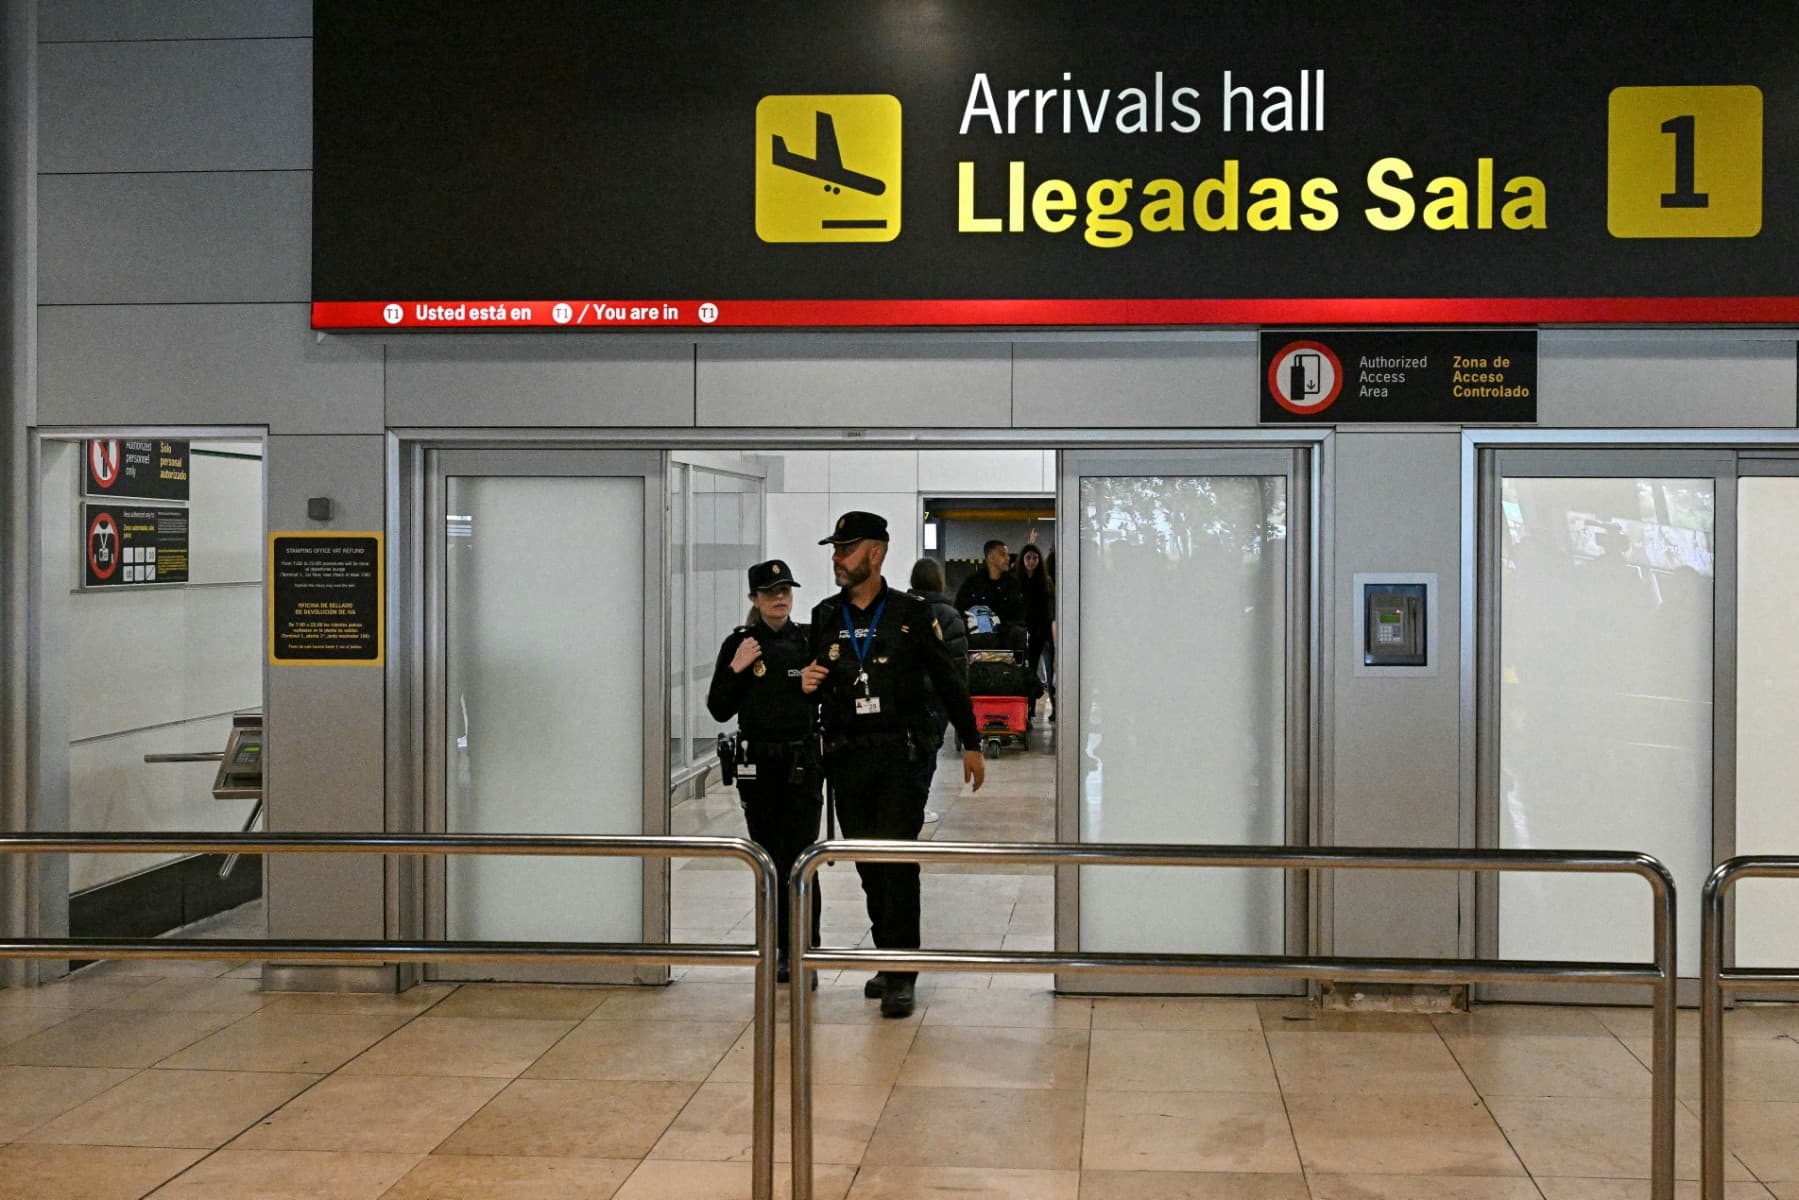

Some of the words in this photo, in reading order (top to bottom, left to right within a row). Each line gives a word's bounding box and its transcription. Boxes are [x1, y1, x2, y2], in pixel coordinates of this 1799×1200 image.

[959, 71, 1201, 134] Arrivals
[1223, 69, 1325, 132] hall
[1660, 115, 1709, 209] 1
[958, 159, 1340, 249] Llegadas
[1364, 156, 1548, 232] Sala
[416, 304, 466, 320] Usted
[469, 304, 507, 320] está
[510, 308, 531, 320] en
[593, 303, 626, 320] You
[630, 307, 659, 320] are
[663, 303, 678, 320] in
[1359, 356, 1427, 369] Authorized
[1453, 356, 1487, 368] Zona
[1493, 356, 1510, 368] de
[1359, 371, 1406, 383] Access
[1453, 371, 1504, 383] Acceso
[1359, 385, 1388, 398] Area
[1453, 385, 1530, 398] Controlado
[160, 457, 182, 468] personal
[126, 465, 136, 479] only
[160, 469, 187, 481] autorizado
